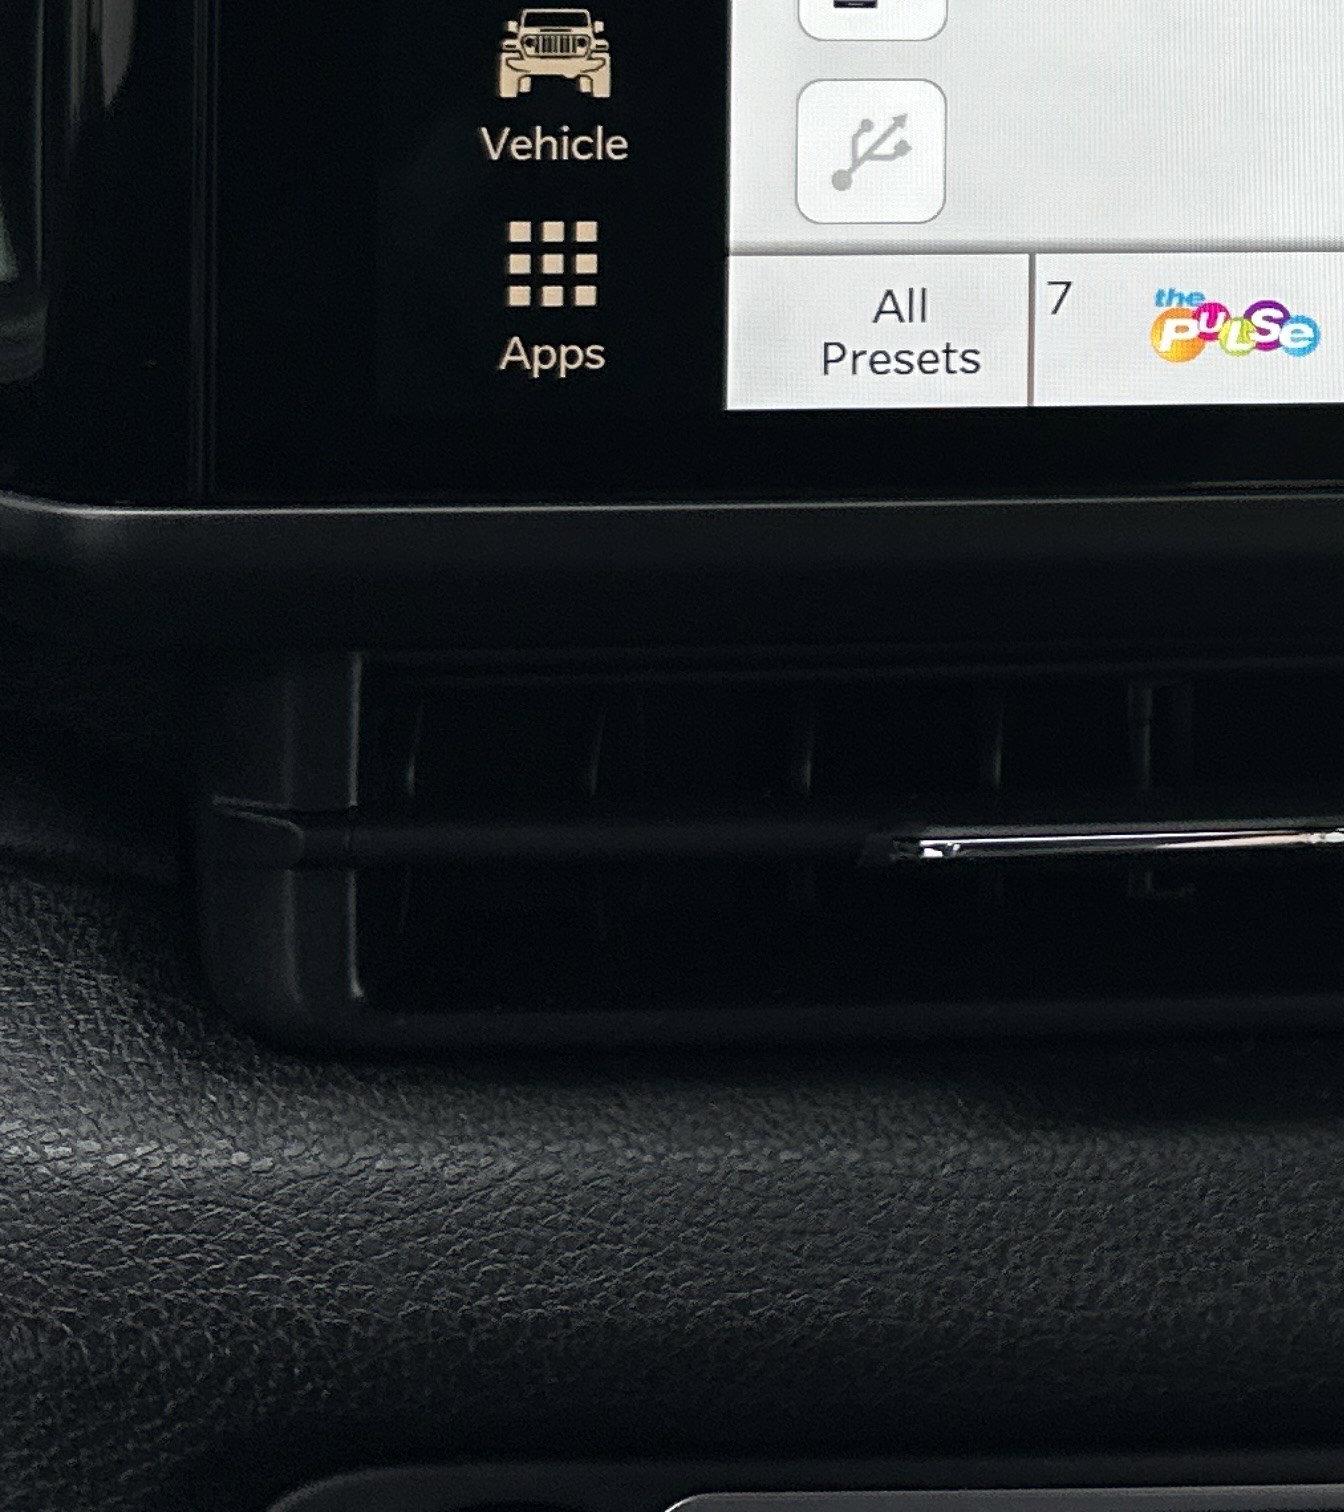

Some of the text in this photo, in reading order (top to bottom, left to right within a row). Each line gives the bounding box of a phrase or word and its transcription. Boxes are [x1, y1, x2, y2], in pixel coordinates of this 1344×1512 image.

[481, 125, 628, 160] Vehicle
[873, 288, 926, 323] All
[1048, 281, 1072, 314] 7
[1154, 288, 1206, 308] the
[499, 336, 605, 378] Apps
[824, 342, 980, 375] Presets
